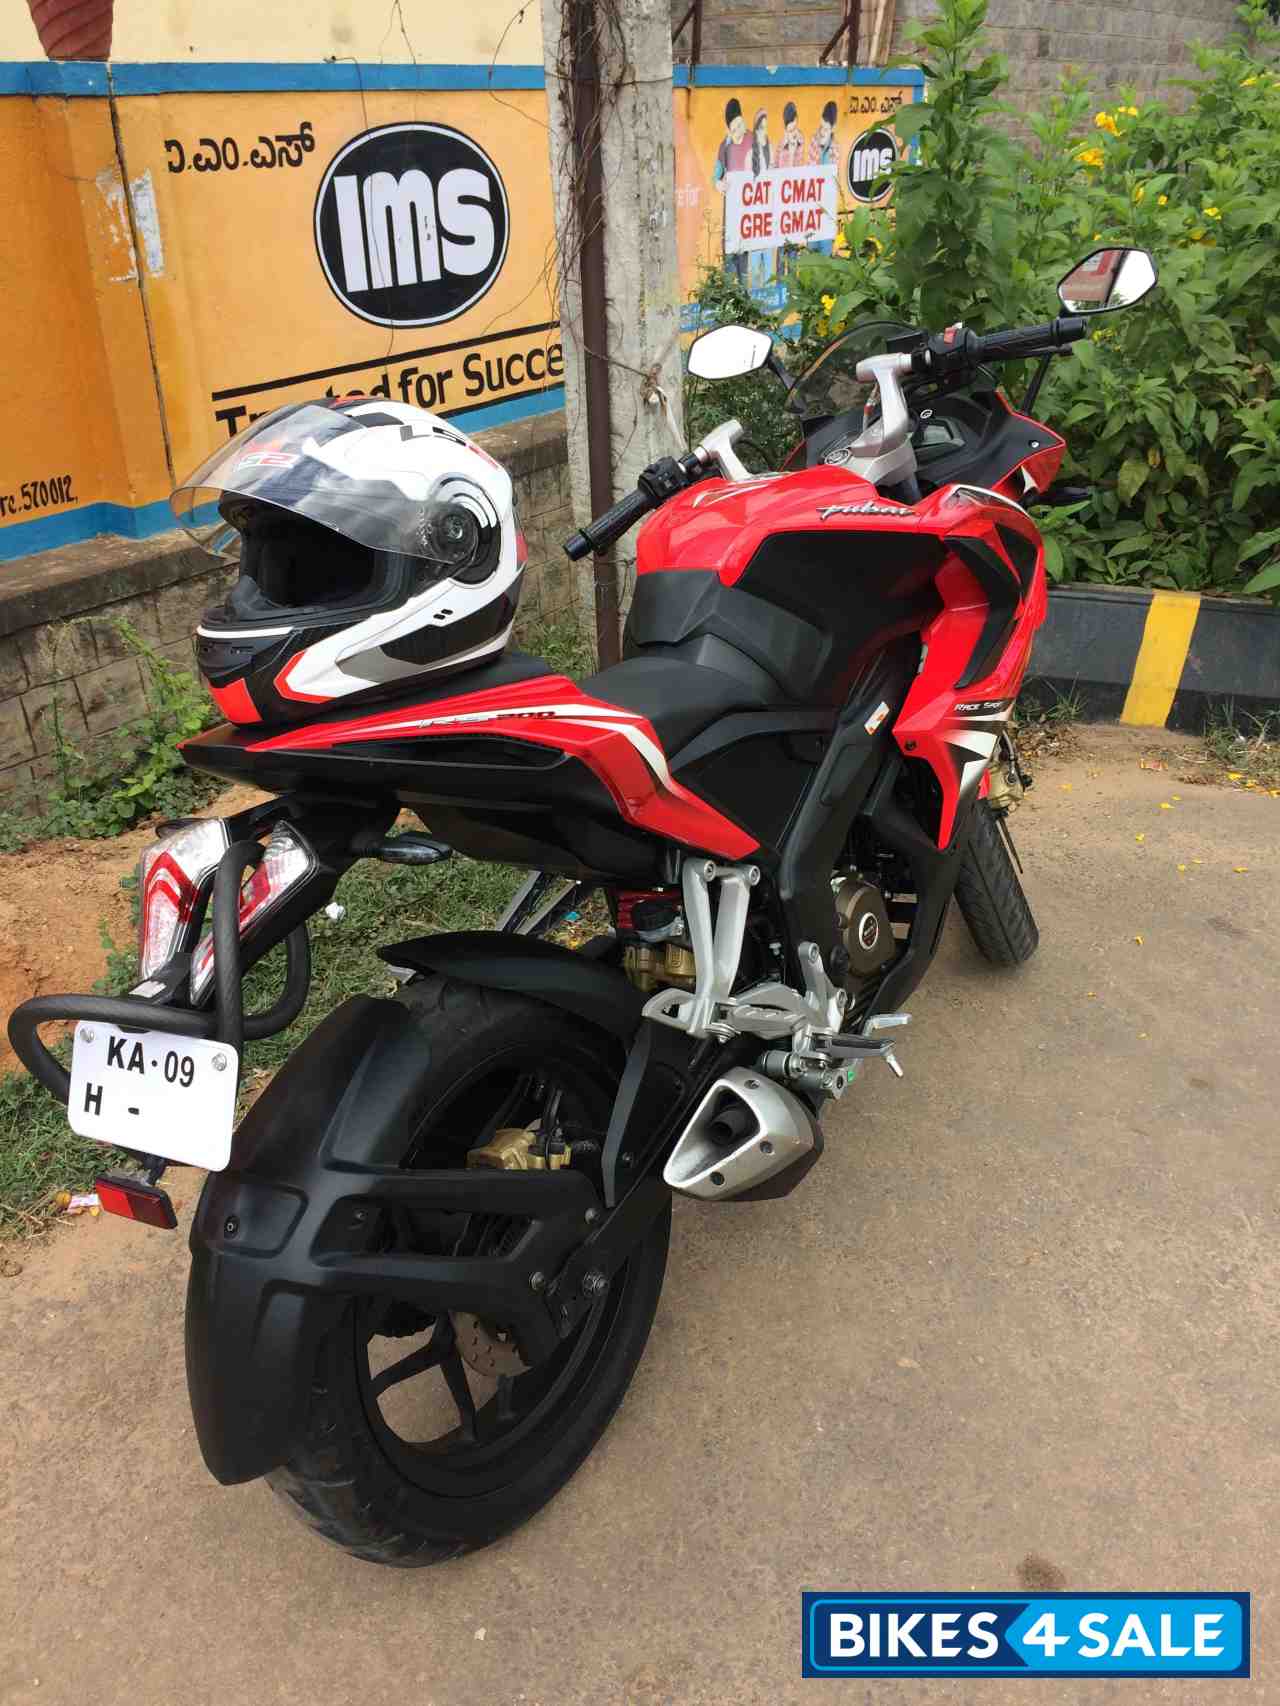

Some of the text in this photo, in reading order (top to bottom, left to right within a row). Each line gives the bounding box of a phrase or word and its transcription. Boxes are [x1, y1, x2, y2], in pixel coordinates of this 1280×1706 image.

[742, 178, 825, 206] CAT CMAT
[740, 212, 773, 239] GRE
[780, 208, 823, 235] GMAT
[398, 367, 453, 408] for
[84, 1082, 103, 1116] H
